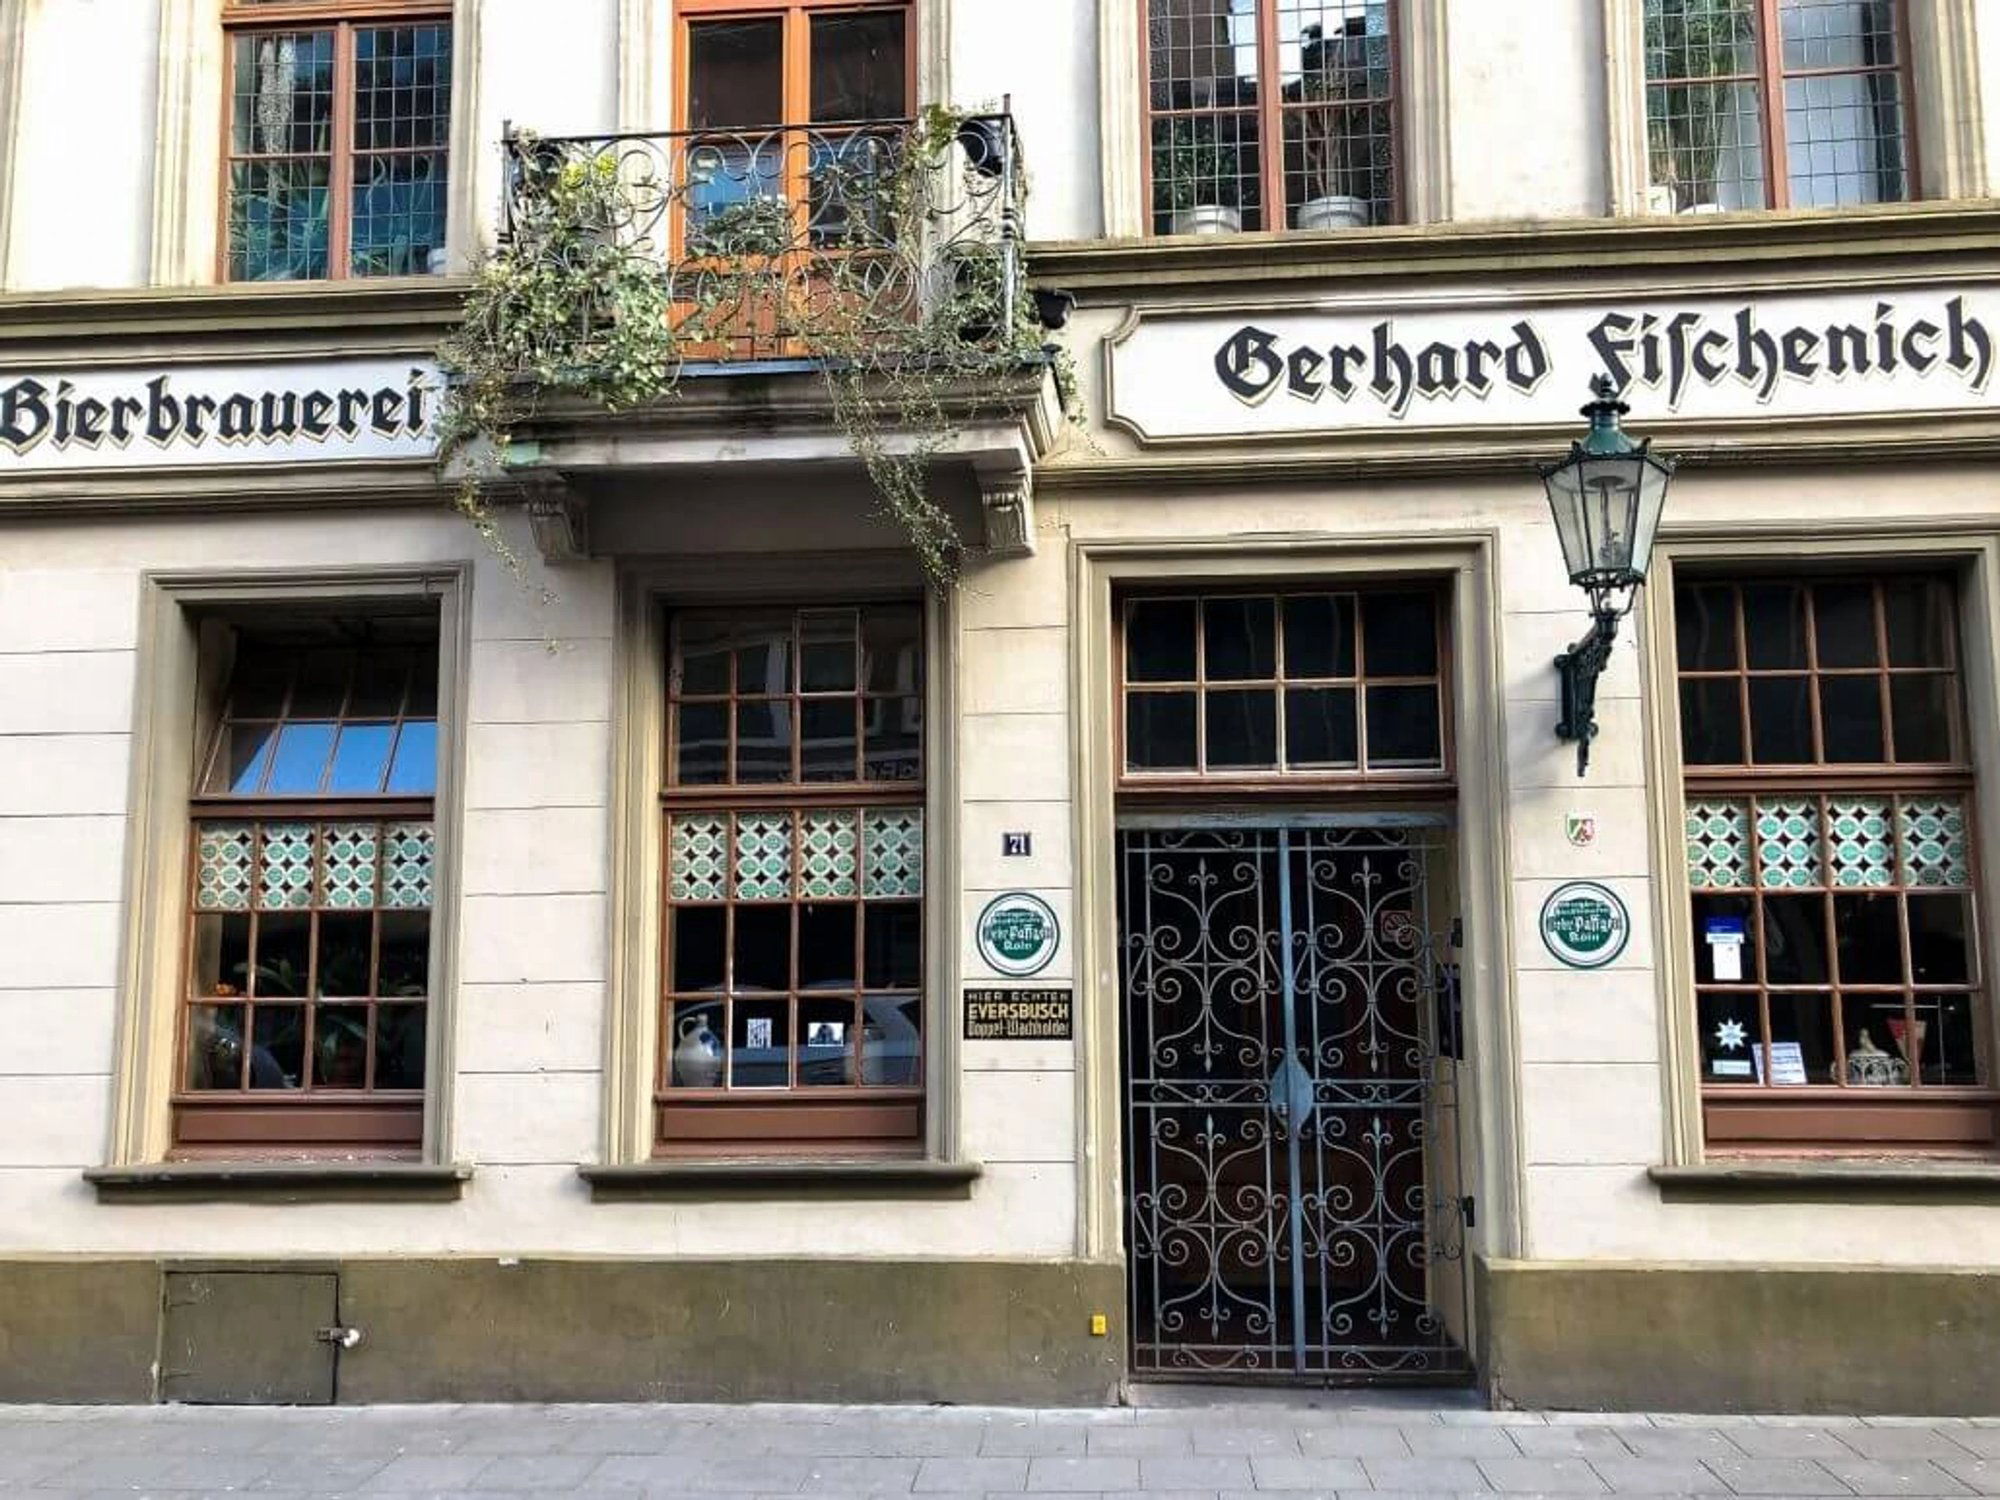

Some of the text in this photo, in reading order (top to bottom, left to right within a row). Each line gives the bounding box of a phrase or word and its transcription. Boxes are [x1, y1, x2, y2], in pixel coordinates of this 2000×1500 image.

[1213, 319, 1554, 419] Gerhard
[0, 368, 429, 456] Bierbrauerei
[1010, 836, 1026, 853] 71
[968, 1003, 1069, 1019] EVERSBUSCH
